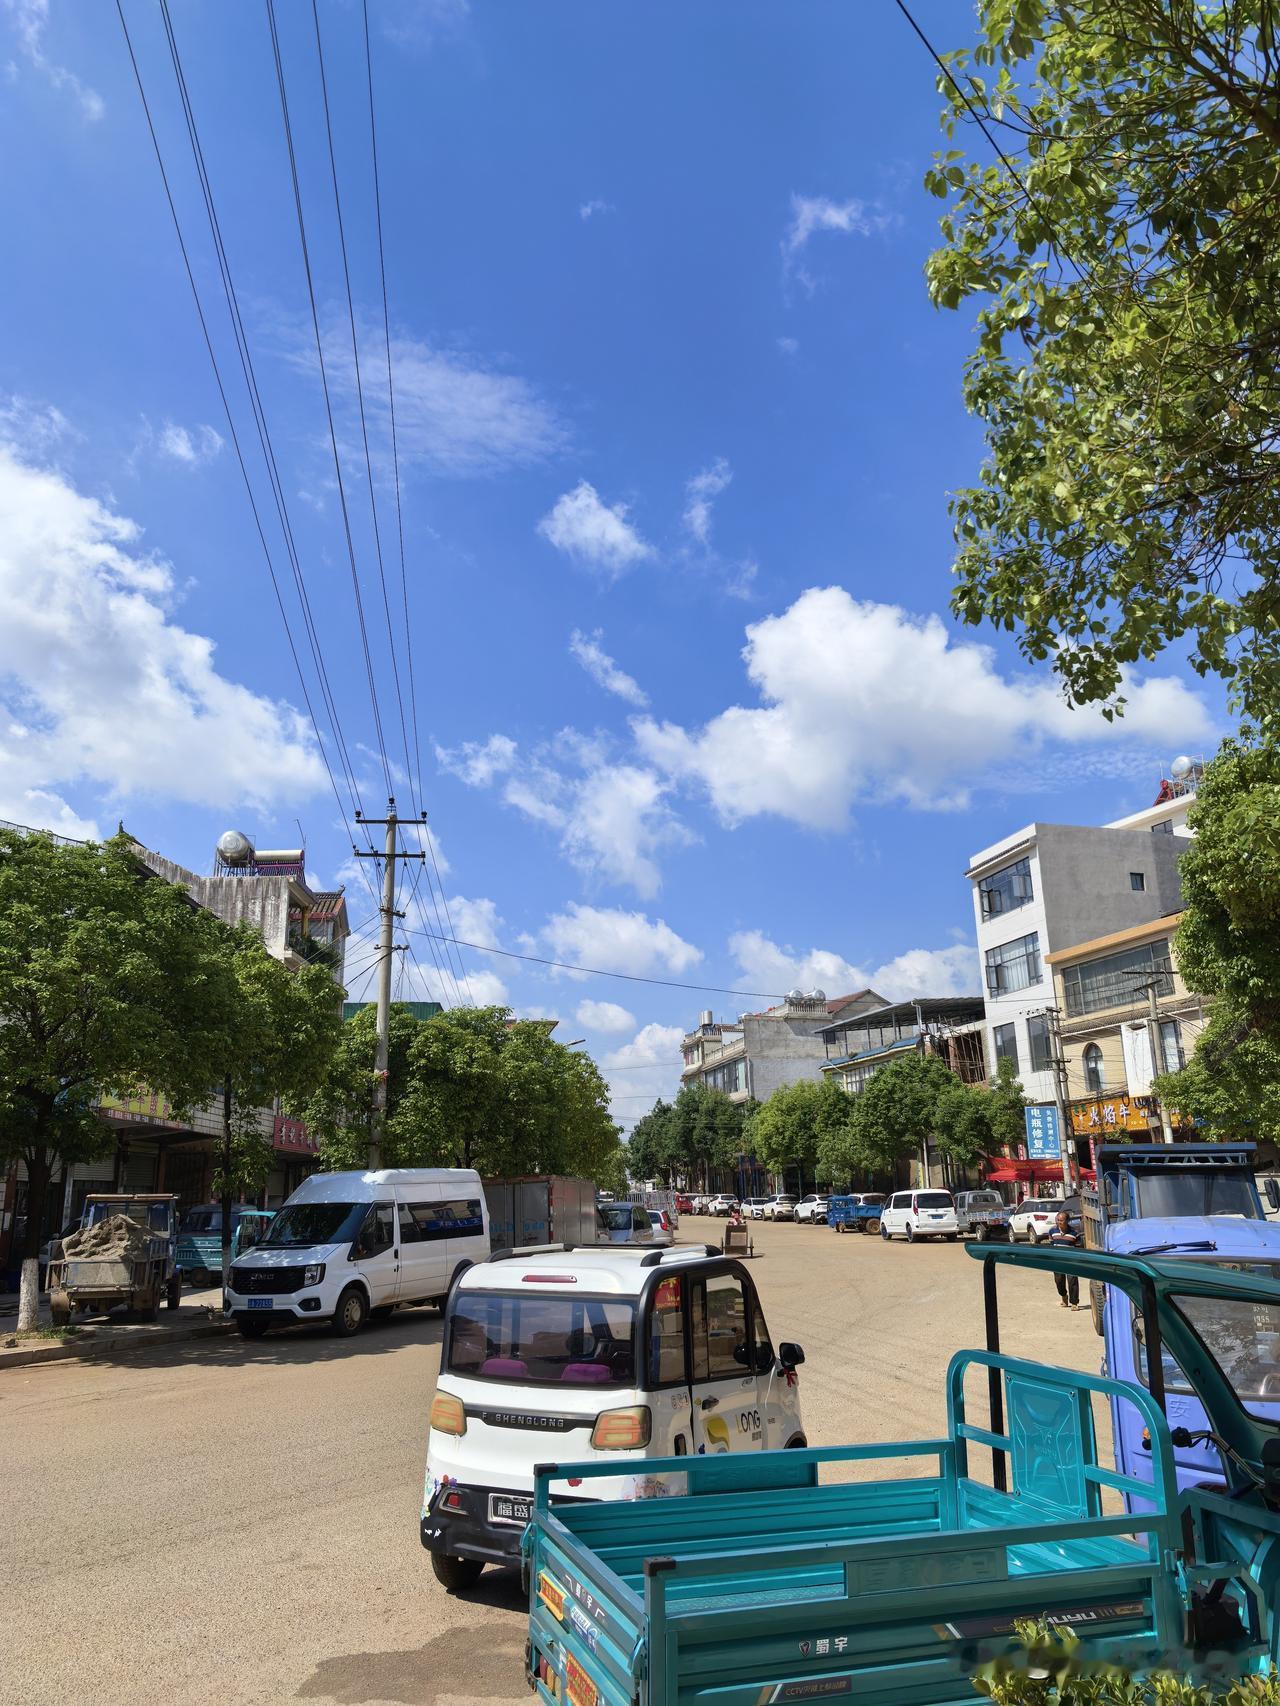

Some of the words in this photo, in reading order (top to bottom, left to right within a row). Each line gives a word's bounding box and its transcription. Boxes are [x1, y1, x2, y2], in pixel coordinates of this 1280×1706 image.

[1030, 1107, 1044, 1149] 电瓶修复
[495, 1413, 564, 1428] SHENGLONG
[815, 1636, 848, 1655] 蜀宇
